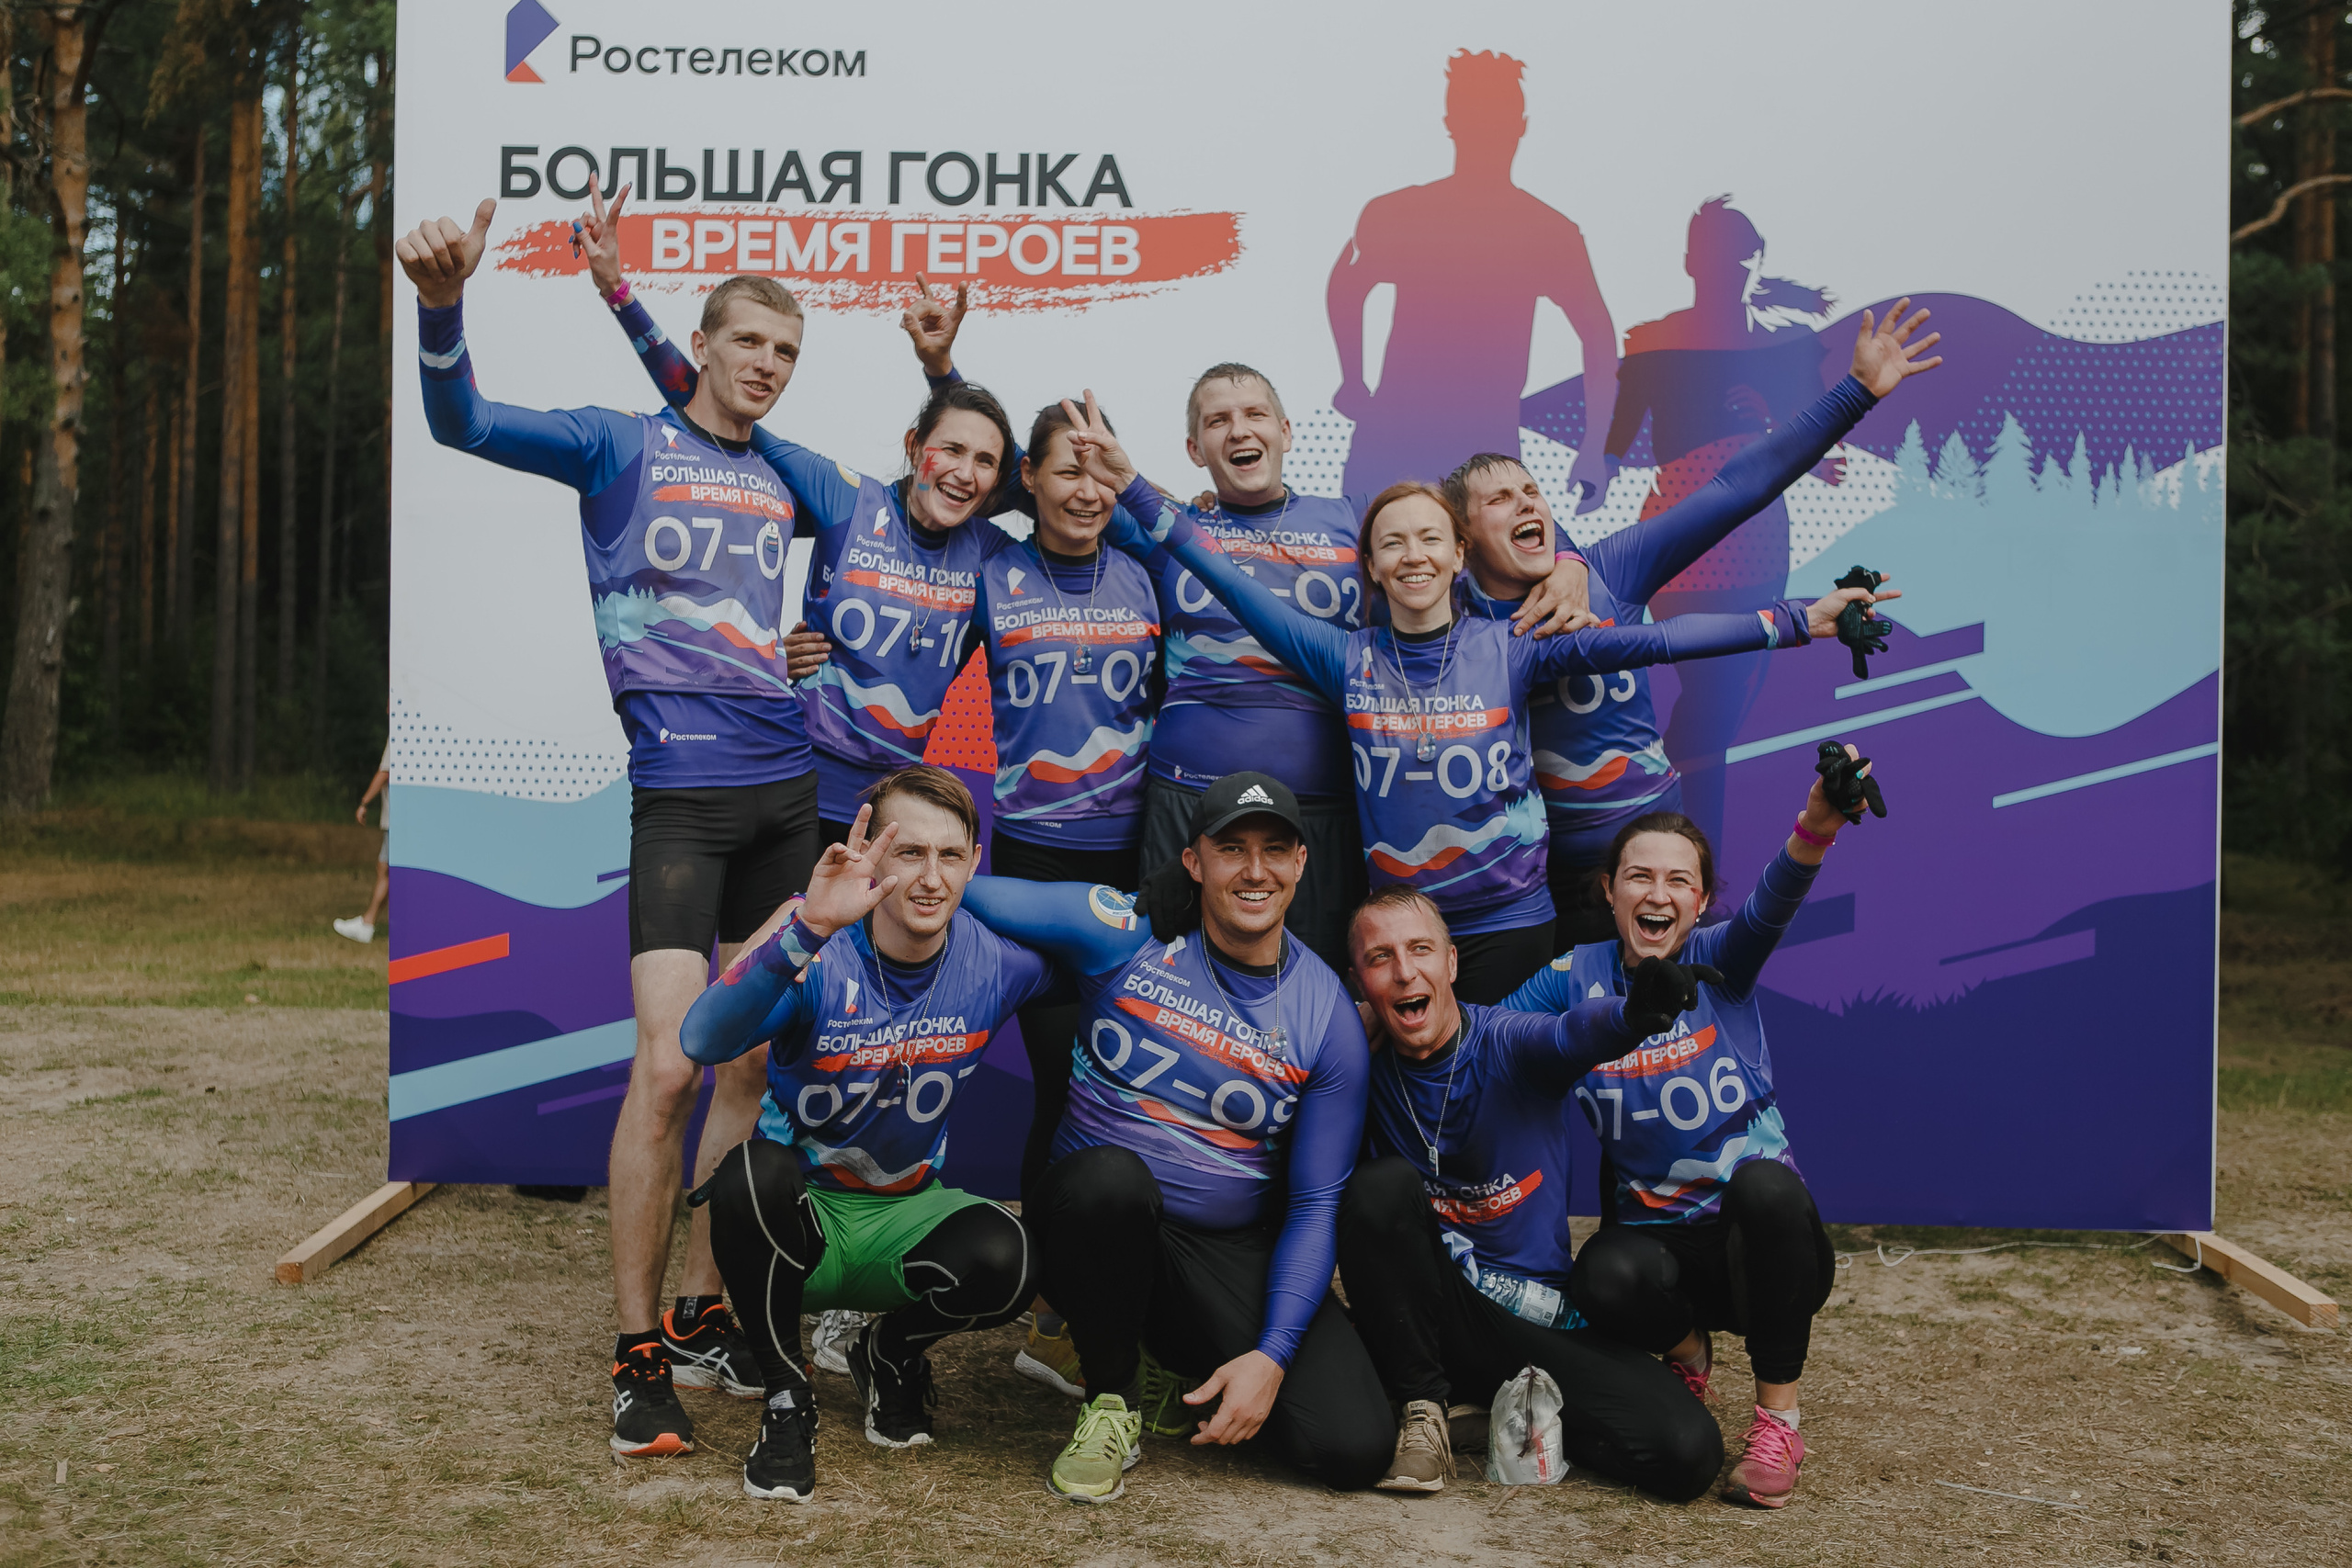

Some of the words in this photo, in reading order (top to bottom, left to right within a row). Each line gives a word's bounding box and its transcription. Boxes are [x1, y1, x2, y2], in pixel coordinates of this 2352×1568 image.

[570, 36, 867, 77] Ростелеком
[501, 146, 862, 204] БОЛЬШАЯ
[889, 152, 1133, 209] ГОНКА
[652, 220, 869, 272] ВРЕМЯ
[890, 222, 1142, 276] ГЕРОЕВ
[651, 466, 738, 487] БОЛЬШАЯ
[691, 486, 741, 503] ВРЕМЯ
[1272, 531, 1333, 547] ГОНКА
[1276, 543, 1338, 561] ГЕРОЕВ
[848, 548, 926, 581] БОЛЬШАЯ
[929, 568, 977, 588] ГОНКА
[878, 575, 927, 597] ВРЕМЯ
[929, 586, 976, 604] ГЕРОЕВ
[996, 597, 1044, 611] Ростелеком
[993, 607, 1080, 632] БОЛЬШАЯ
[1083, 607, 1140, 622] ГОНКА
[1032, 623, 1084, 638] ВРЕМЯ
[1088, 622, 1148, 637] ГЕРОЕВ
[1424, 694, 1485, 714] ГОНКА
[1425, 713, 1488, 730] ГЕРОЕВ
[670, 732, 717, 741] Ростелеком
[1237, 795, 1274, 806] adidas
[1139, 960, 1192, 988] Ростелеком
[1123, 974, 1224, 1029] БОЛЬШАЯ
[909, 1016, 967, 1038] ГОНКА
[906, 1037, 967, 1055] ГЕРОЕВ
[1155, 1009, 1218, 1048] ВРЕМЯ
[1219, 1037, 1286, 1078] ГЕРОЕВ
[1641, 1037, 1699, 1066] ГЕРОЕВ
